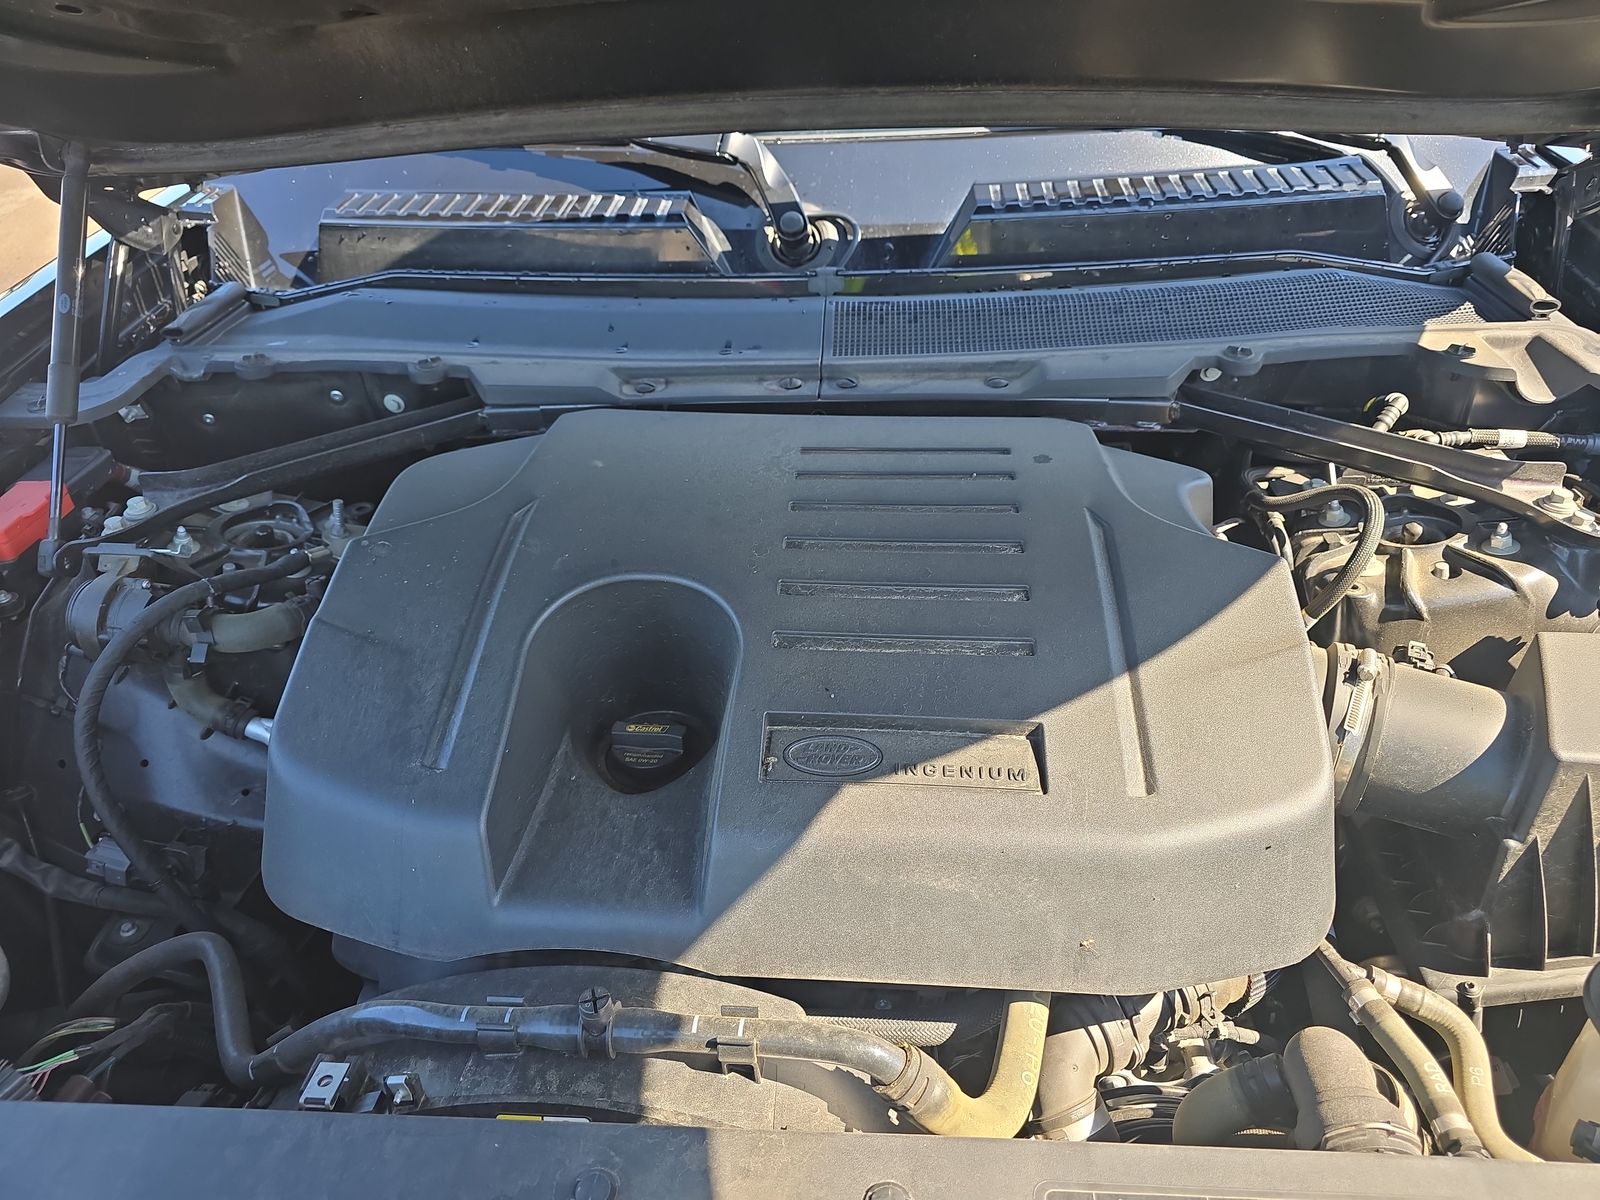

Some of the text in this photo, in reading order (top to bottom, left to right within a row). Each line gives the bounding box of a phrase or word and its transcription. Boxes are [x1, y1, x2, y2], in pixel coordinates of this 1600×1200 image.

[894, 763, 1027, 782] INGENIUM
[1423, 1061, 1450, 1093] RAD
[1469, 1065, 1485, 1087] P6
